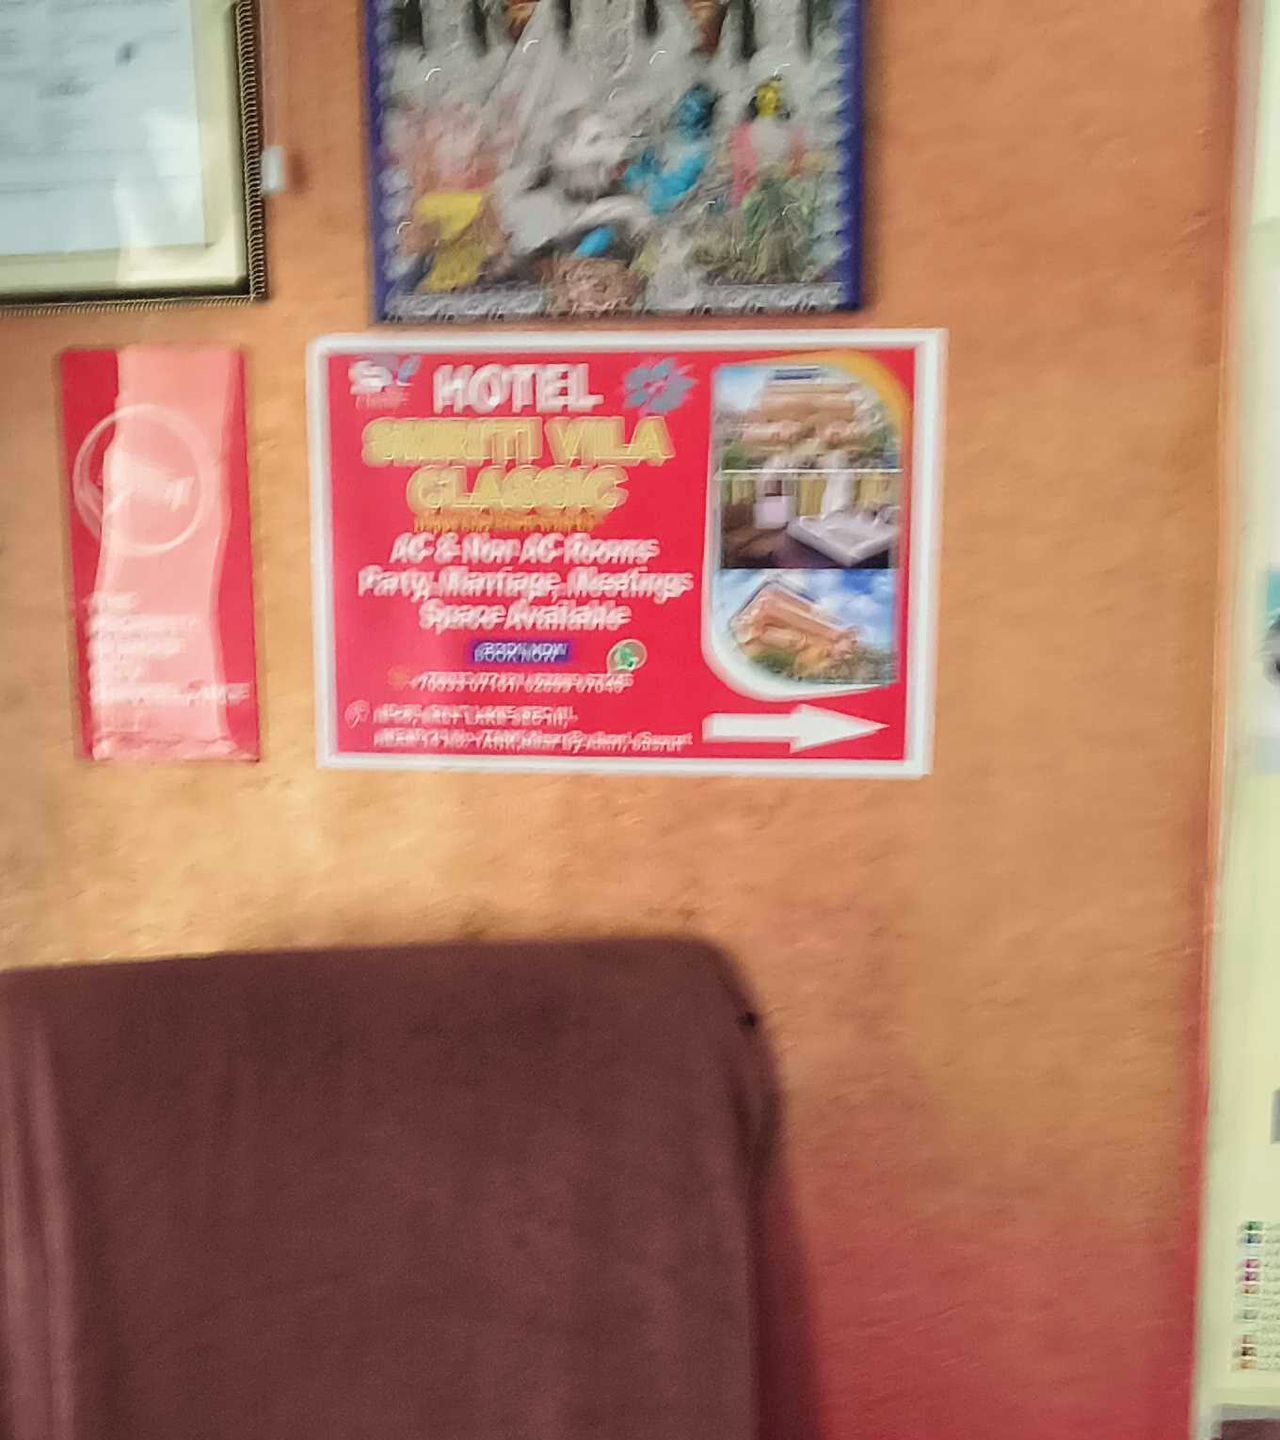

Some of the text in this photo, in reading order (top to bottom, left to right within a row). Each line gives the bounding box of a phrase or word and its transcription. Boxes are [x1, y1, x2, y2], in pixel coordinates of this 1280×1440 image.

[433, 363, 604, 414] HOTEL
[407, 465, 629, 513] CLASSIC
[389, 532, 434, 563] AC
[435, 532, 460, 563] &
[521, 533, 564, 564] AC
[565, 533, 660, 564] Rooms
[568, 566, 694, 604] Meetings
[420, 598, 632, 635] Space Available
